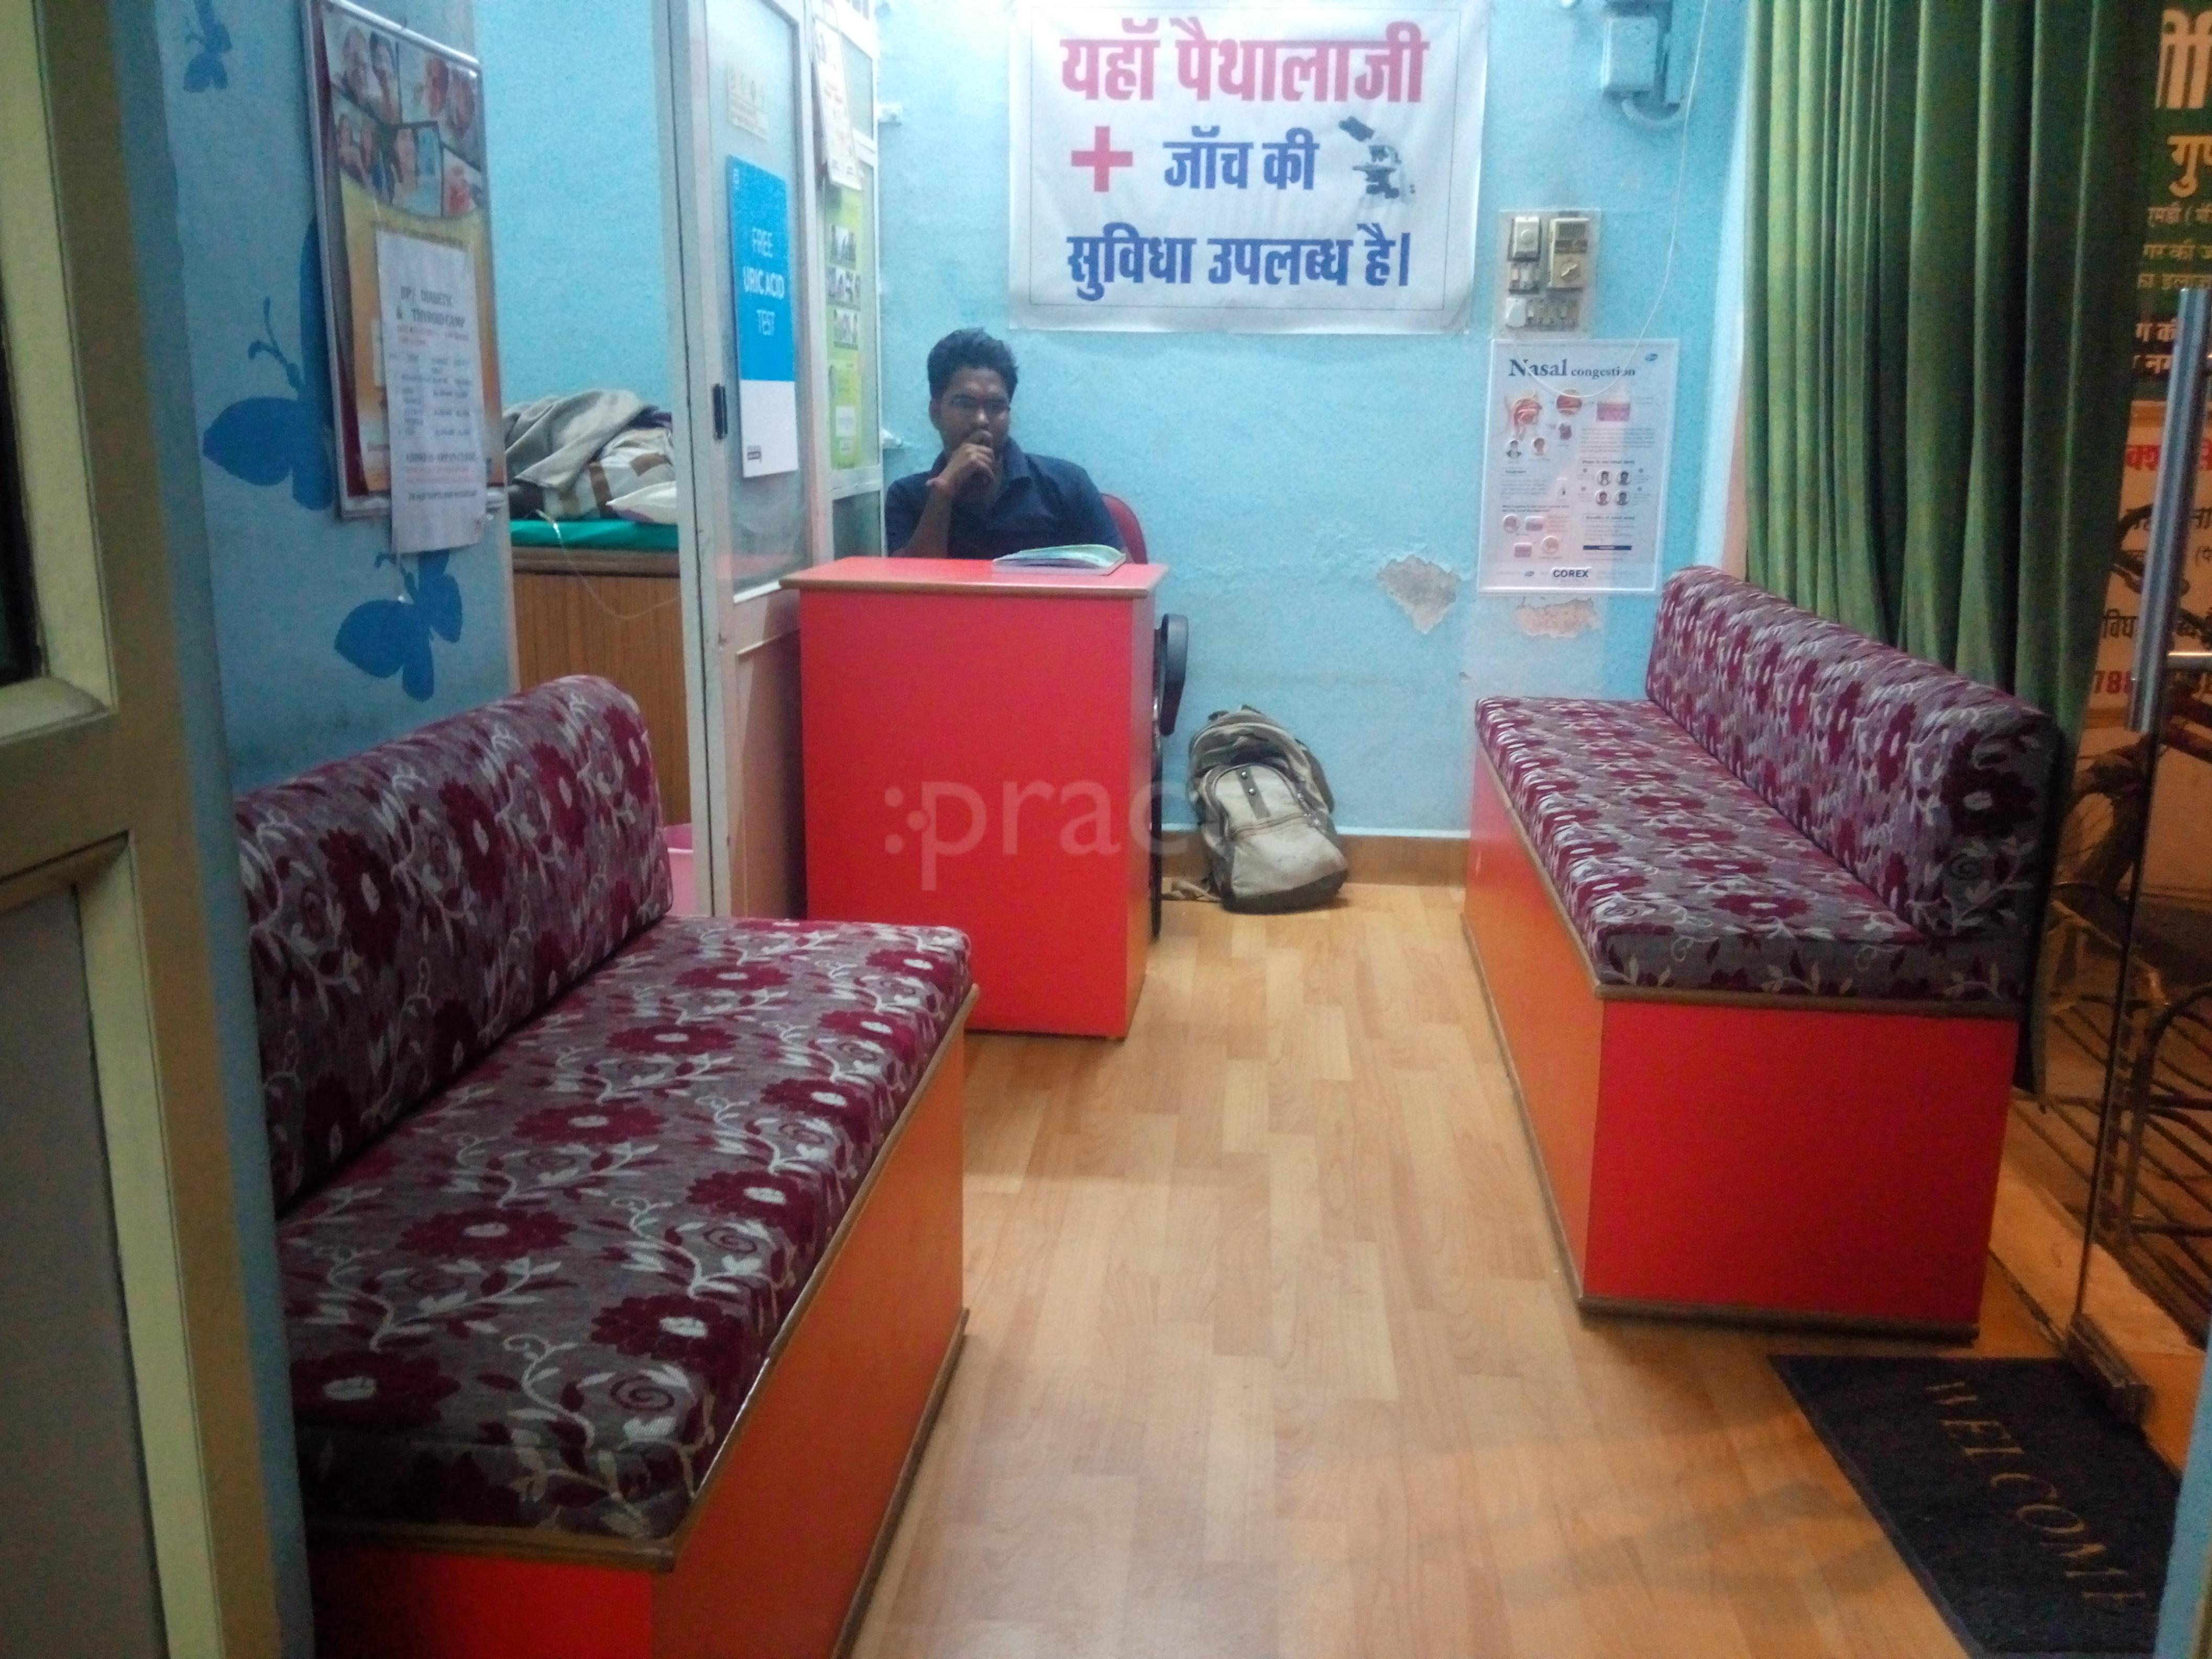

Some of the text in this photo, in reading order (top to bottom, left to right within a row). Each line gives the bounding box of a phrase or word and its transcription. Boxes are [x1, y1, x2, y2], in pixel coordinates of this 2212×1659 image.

[1262, 127, 1320, 190] की
[751, 226, 773, 258] FREE
[1066, 221, 1198, 302] सुविधा
[1207, 237, 1354, 286] उपलब्ध
[756, 308, 776, 336] TEST
[1508, 359, 1635, 380] Nasal congestion
[1553, 569, 1589, 578] COREX
